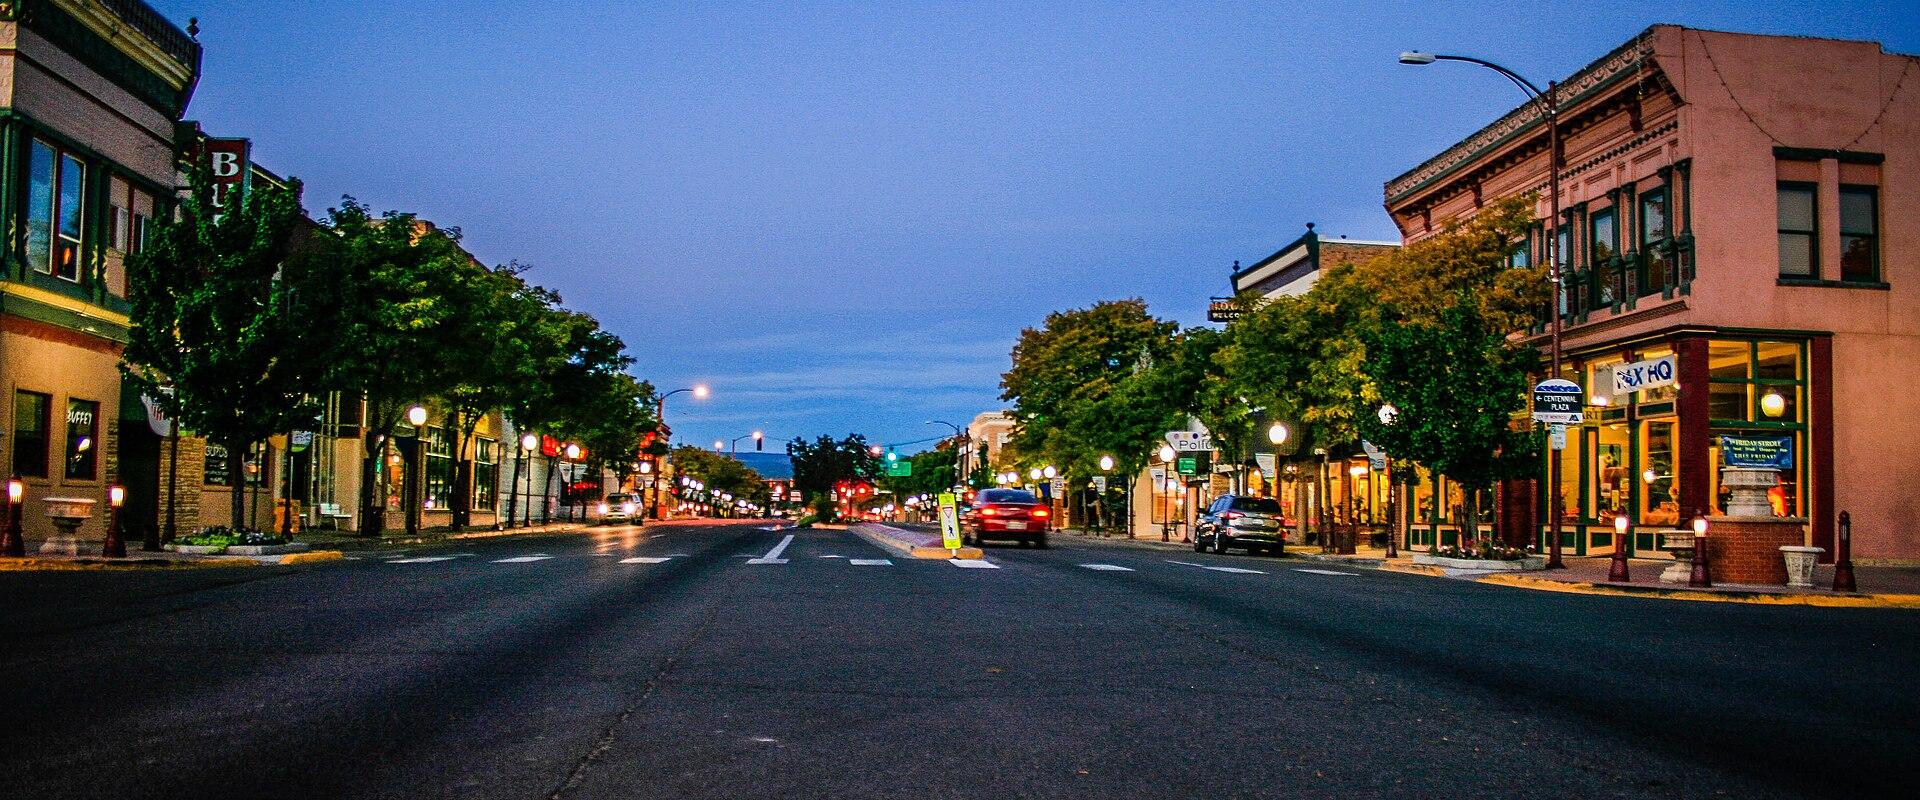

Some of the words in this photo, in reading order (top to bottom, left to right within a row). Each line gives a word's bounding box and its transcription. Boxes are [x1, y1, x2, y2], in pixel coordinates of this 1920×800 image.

[1648, 360, 1672, 383] HQ
[1543, 395, 1577, 403] CENTENNIAL
[1551, 403, 1570, 411] PLAZA
[1180, 440, 1213, 450] Polic
